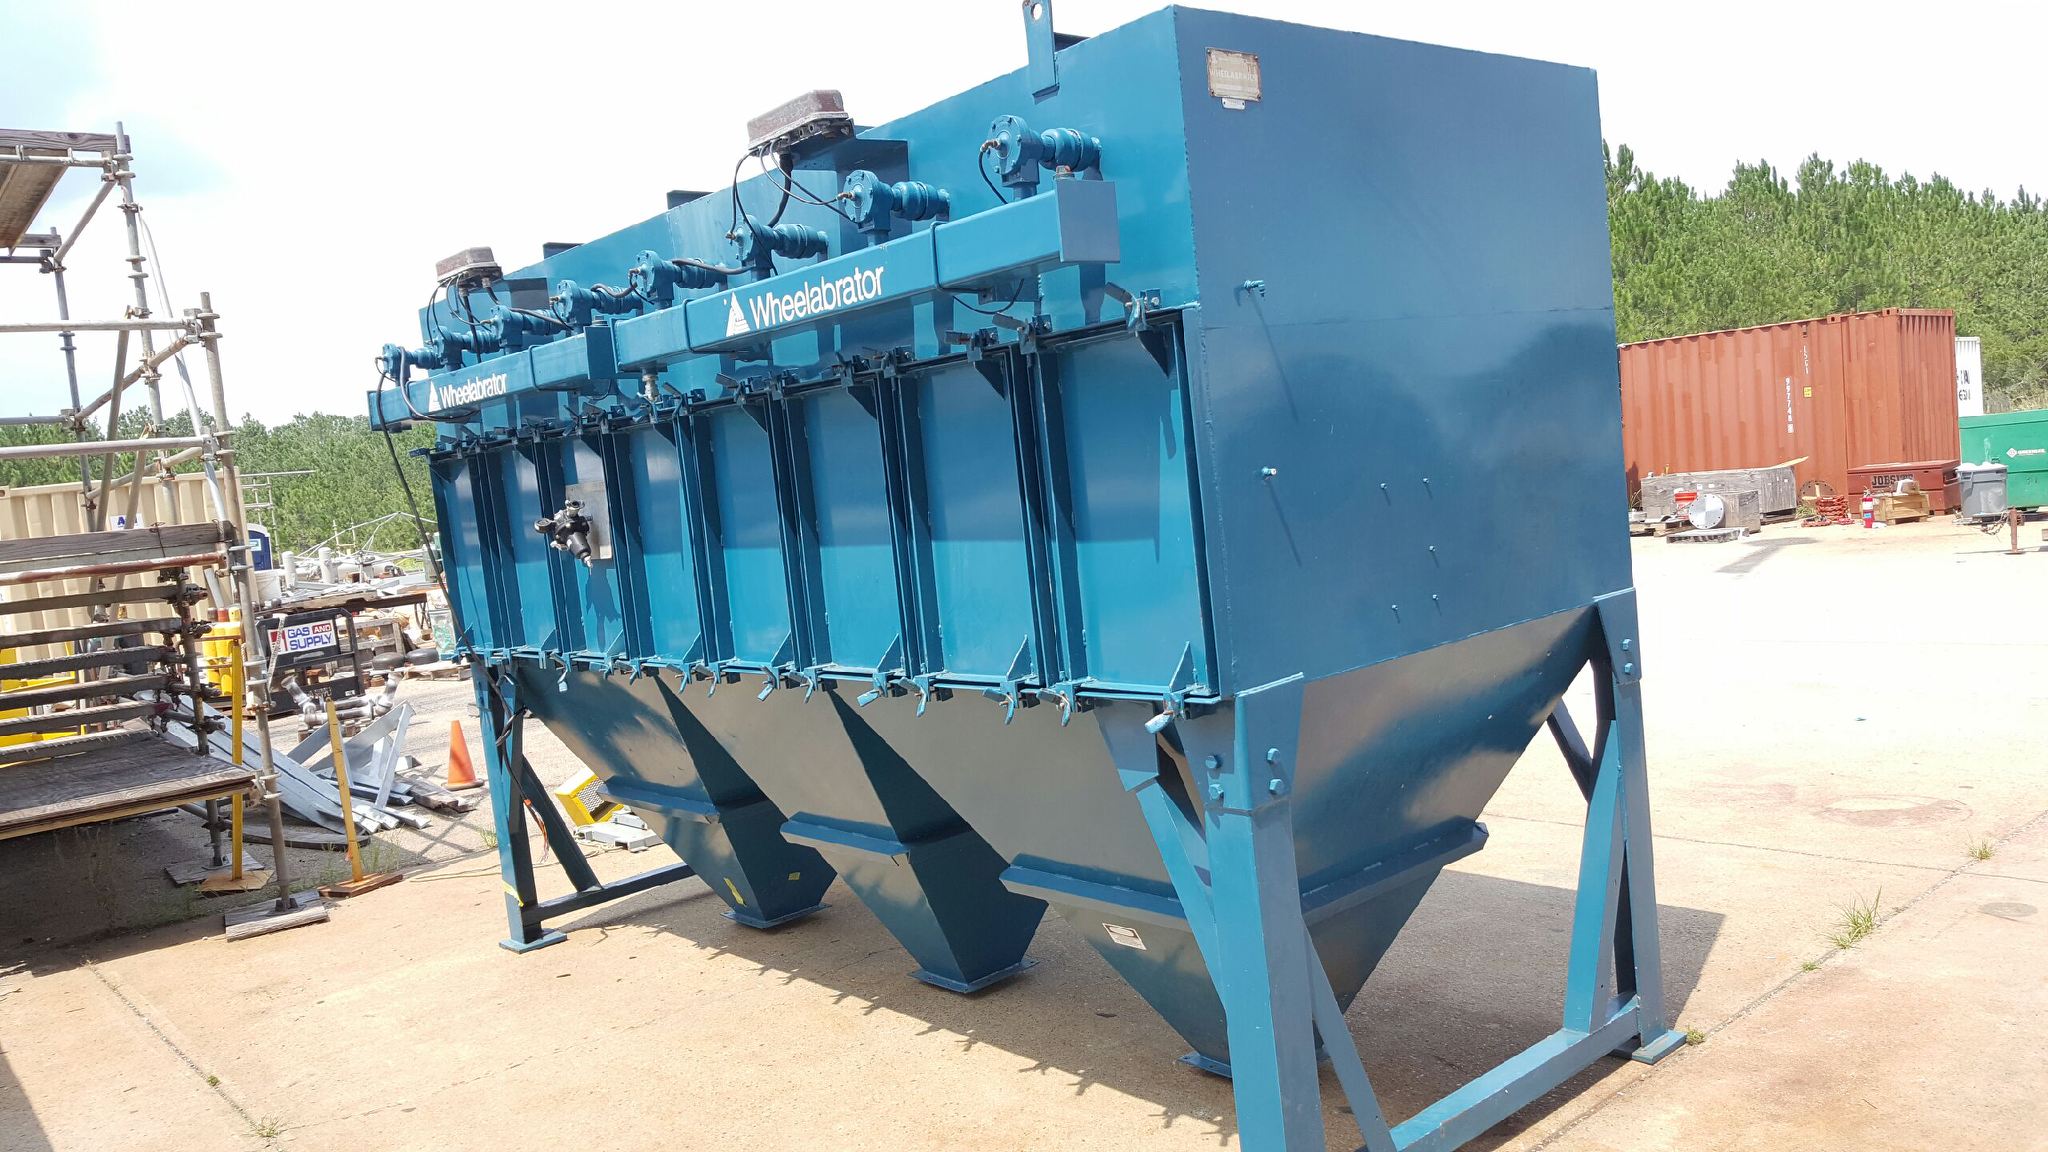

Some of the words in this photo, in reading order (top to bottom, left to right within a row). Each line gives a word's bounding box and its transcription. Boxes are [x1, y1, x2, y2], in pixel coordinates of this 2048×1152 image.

[750, 266, 884, 329] Wheelabrator
[439, 373, 507, 408] Wheelabrator
[288, 627, 310, 639] GAS
[314, 625, 331, 634] AND
[290, 634, 332, 650] SUPPLY
